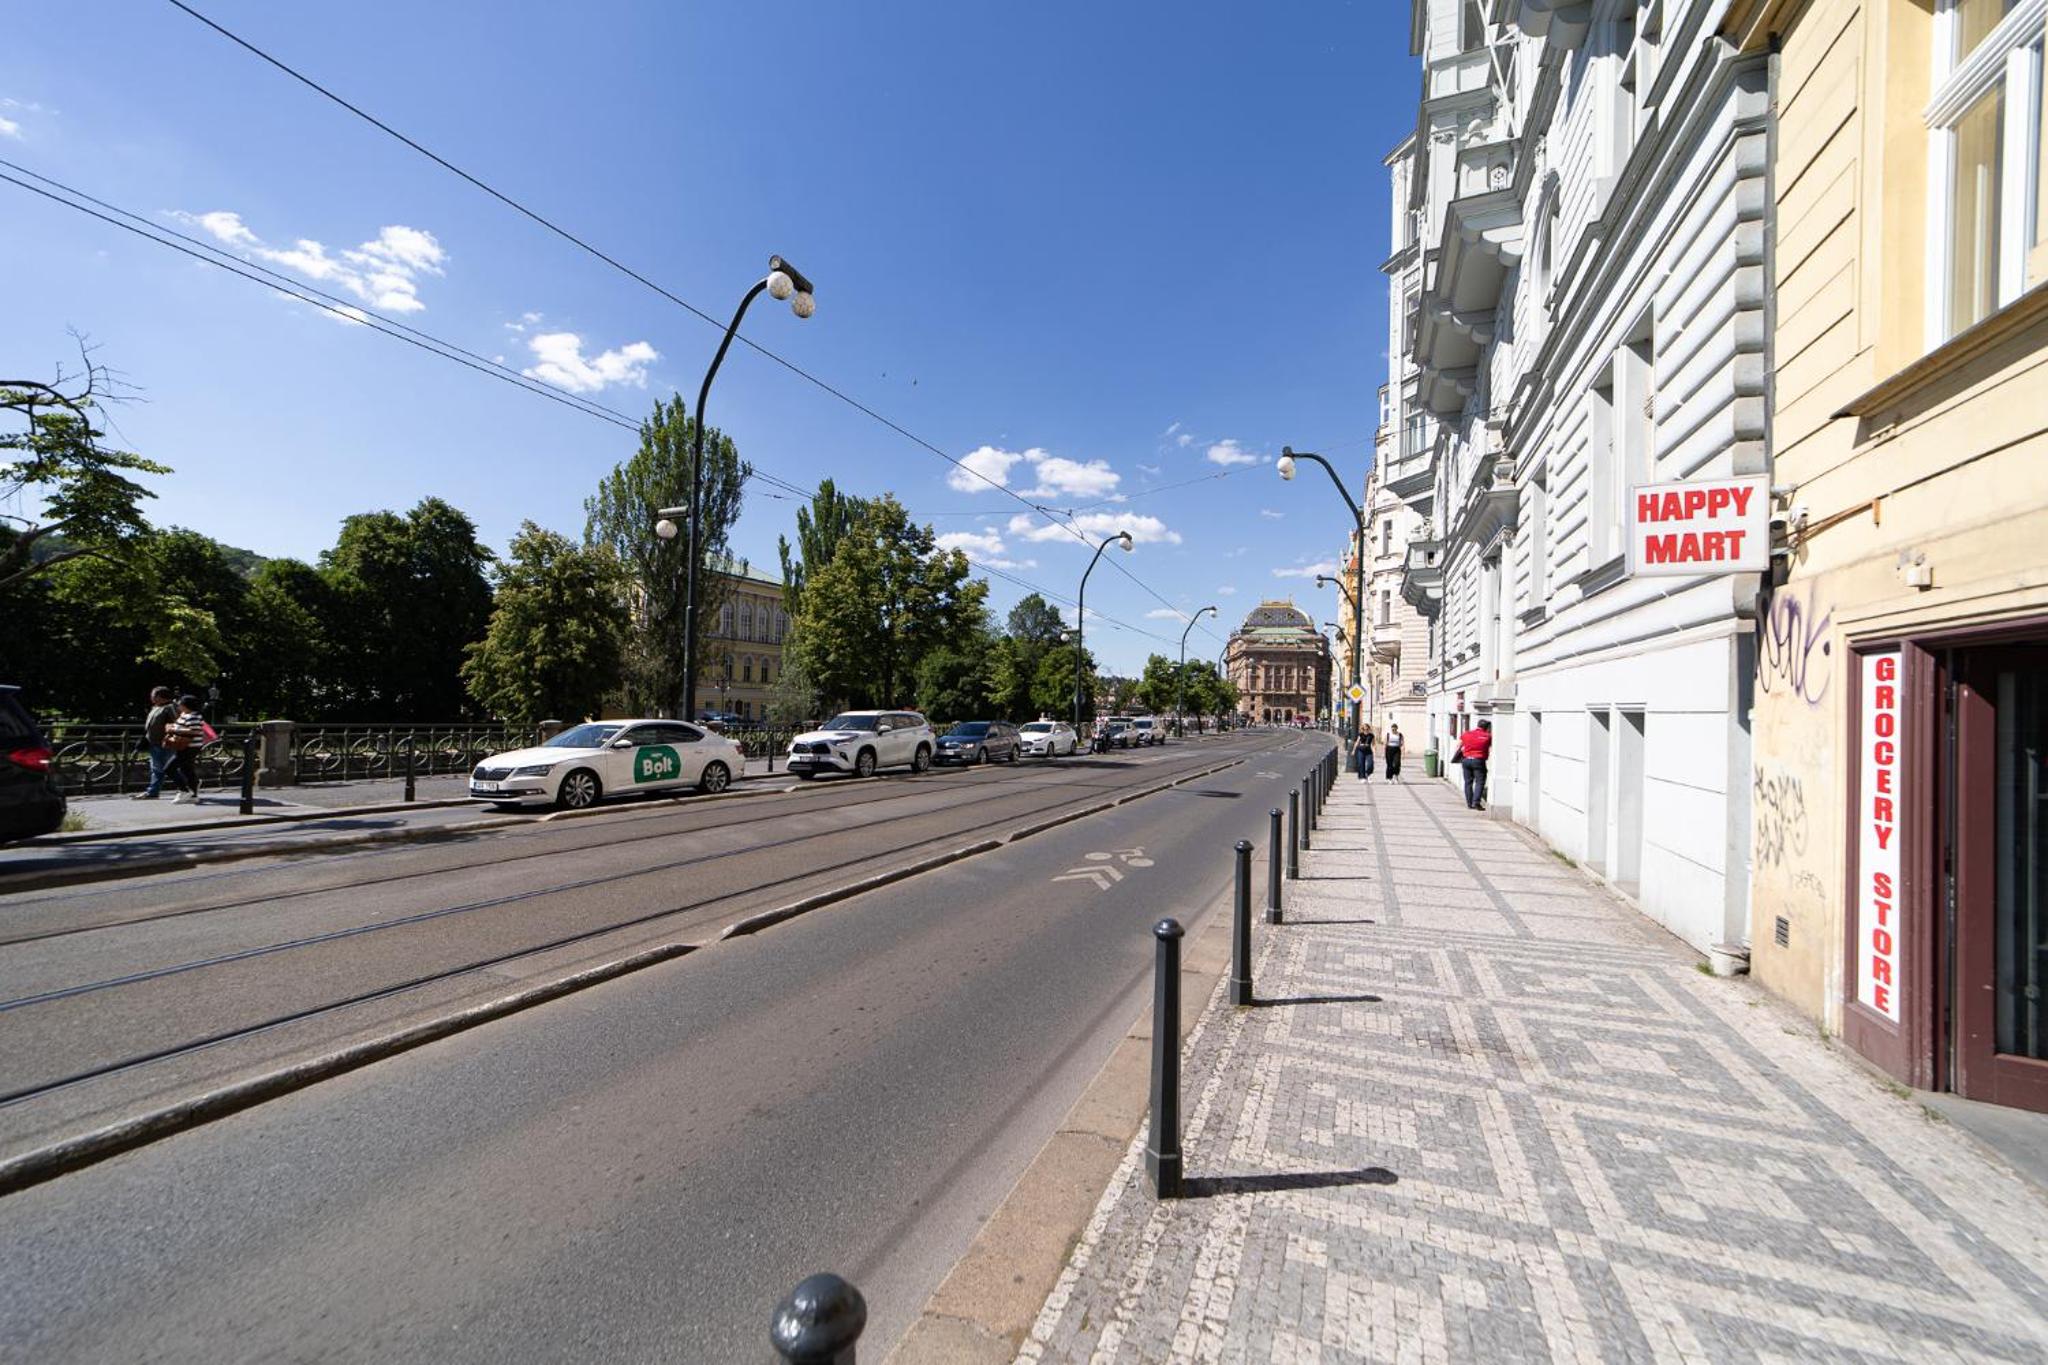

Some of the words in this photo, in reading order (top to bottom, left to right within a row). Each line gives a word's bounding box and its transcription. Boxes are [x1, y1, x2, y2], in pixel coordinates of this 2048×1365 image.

[1638, 487, 1752, 522] HAPPY
[1645, 530, 1745, 563] MART
[642, 756, 673, 777] Bolt
[1874, 657, 1894, 848] GROCERY
[1873, 872, 1892, 1011] STORE
